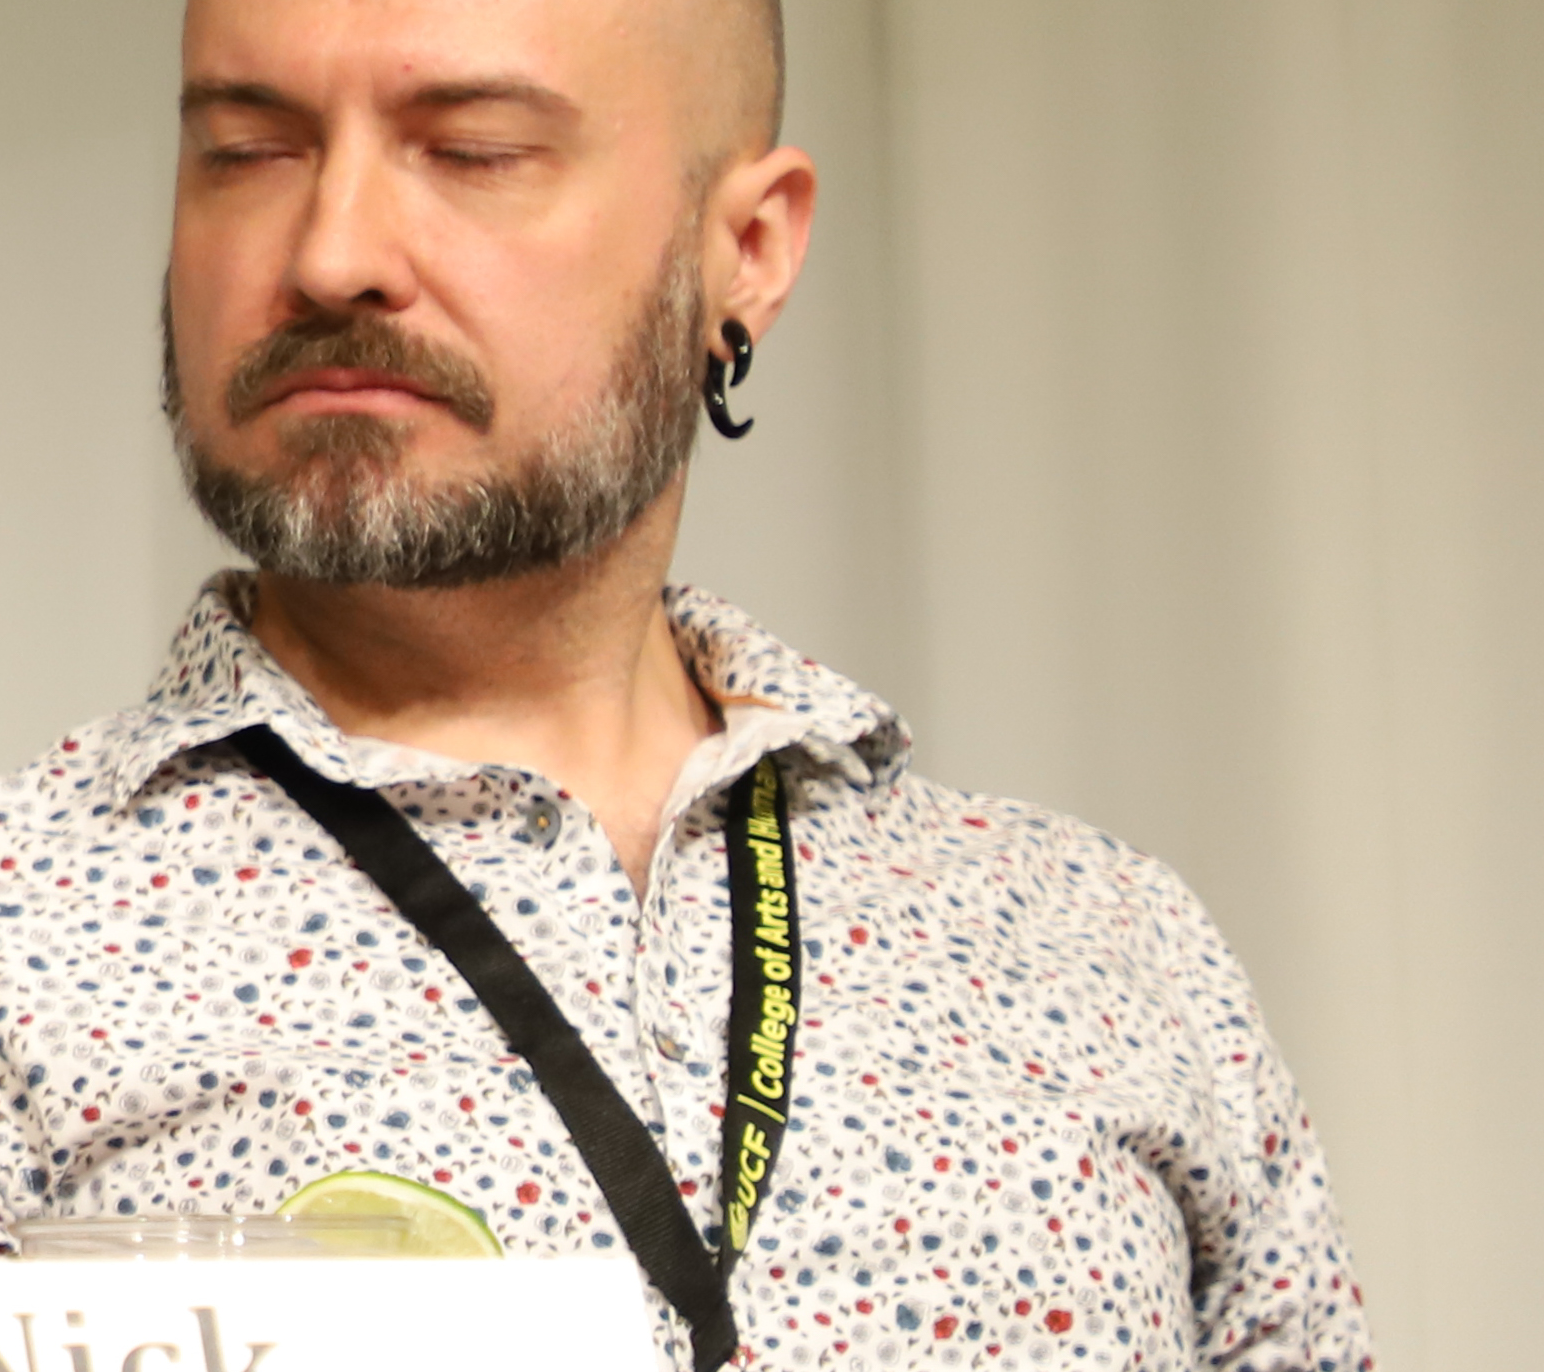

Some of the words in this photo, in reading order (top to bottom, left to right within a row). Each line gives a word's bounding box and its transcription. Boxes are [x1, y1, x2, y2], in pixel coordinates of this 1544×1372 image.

[747, 838, 786, 889] and
[755, 888, 790, 947] Arts
[754, 946, 792, 982] of
[750, 984, 797, 1100] College
[736, 1122, 771, 1209] UCF
